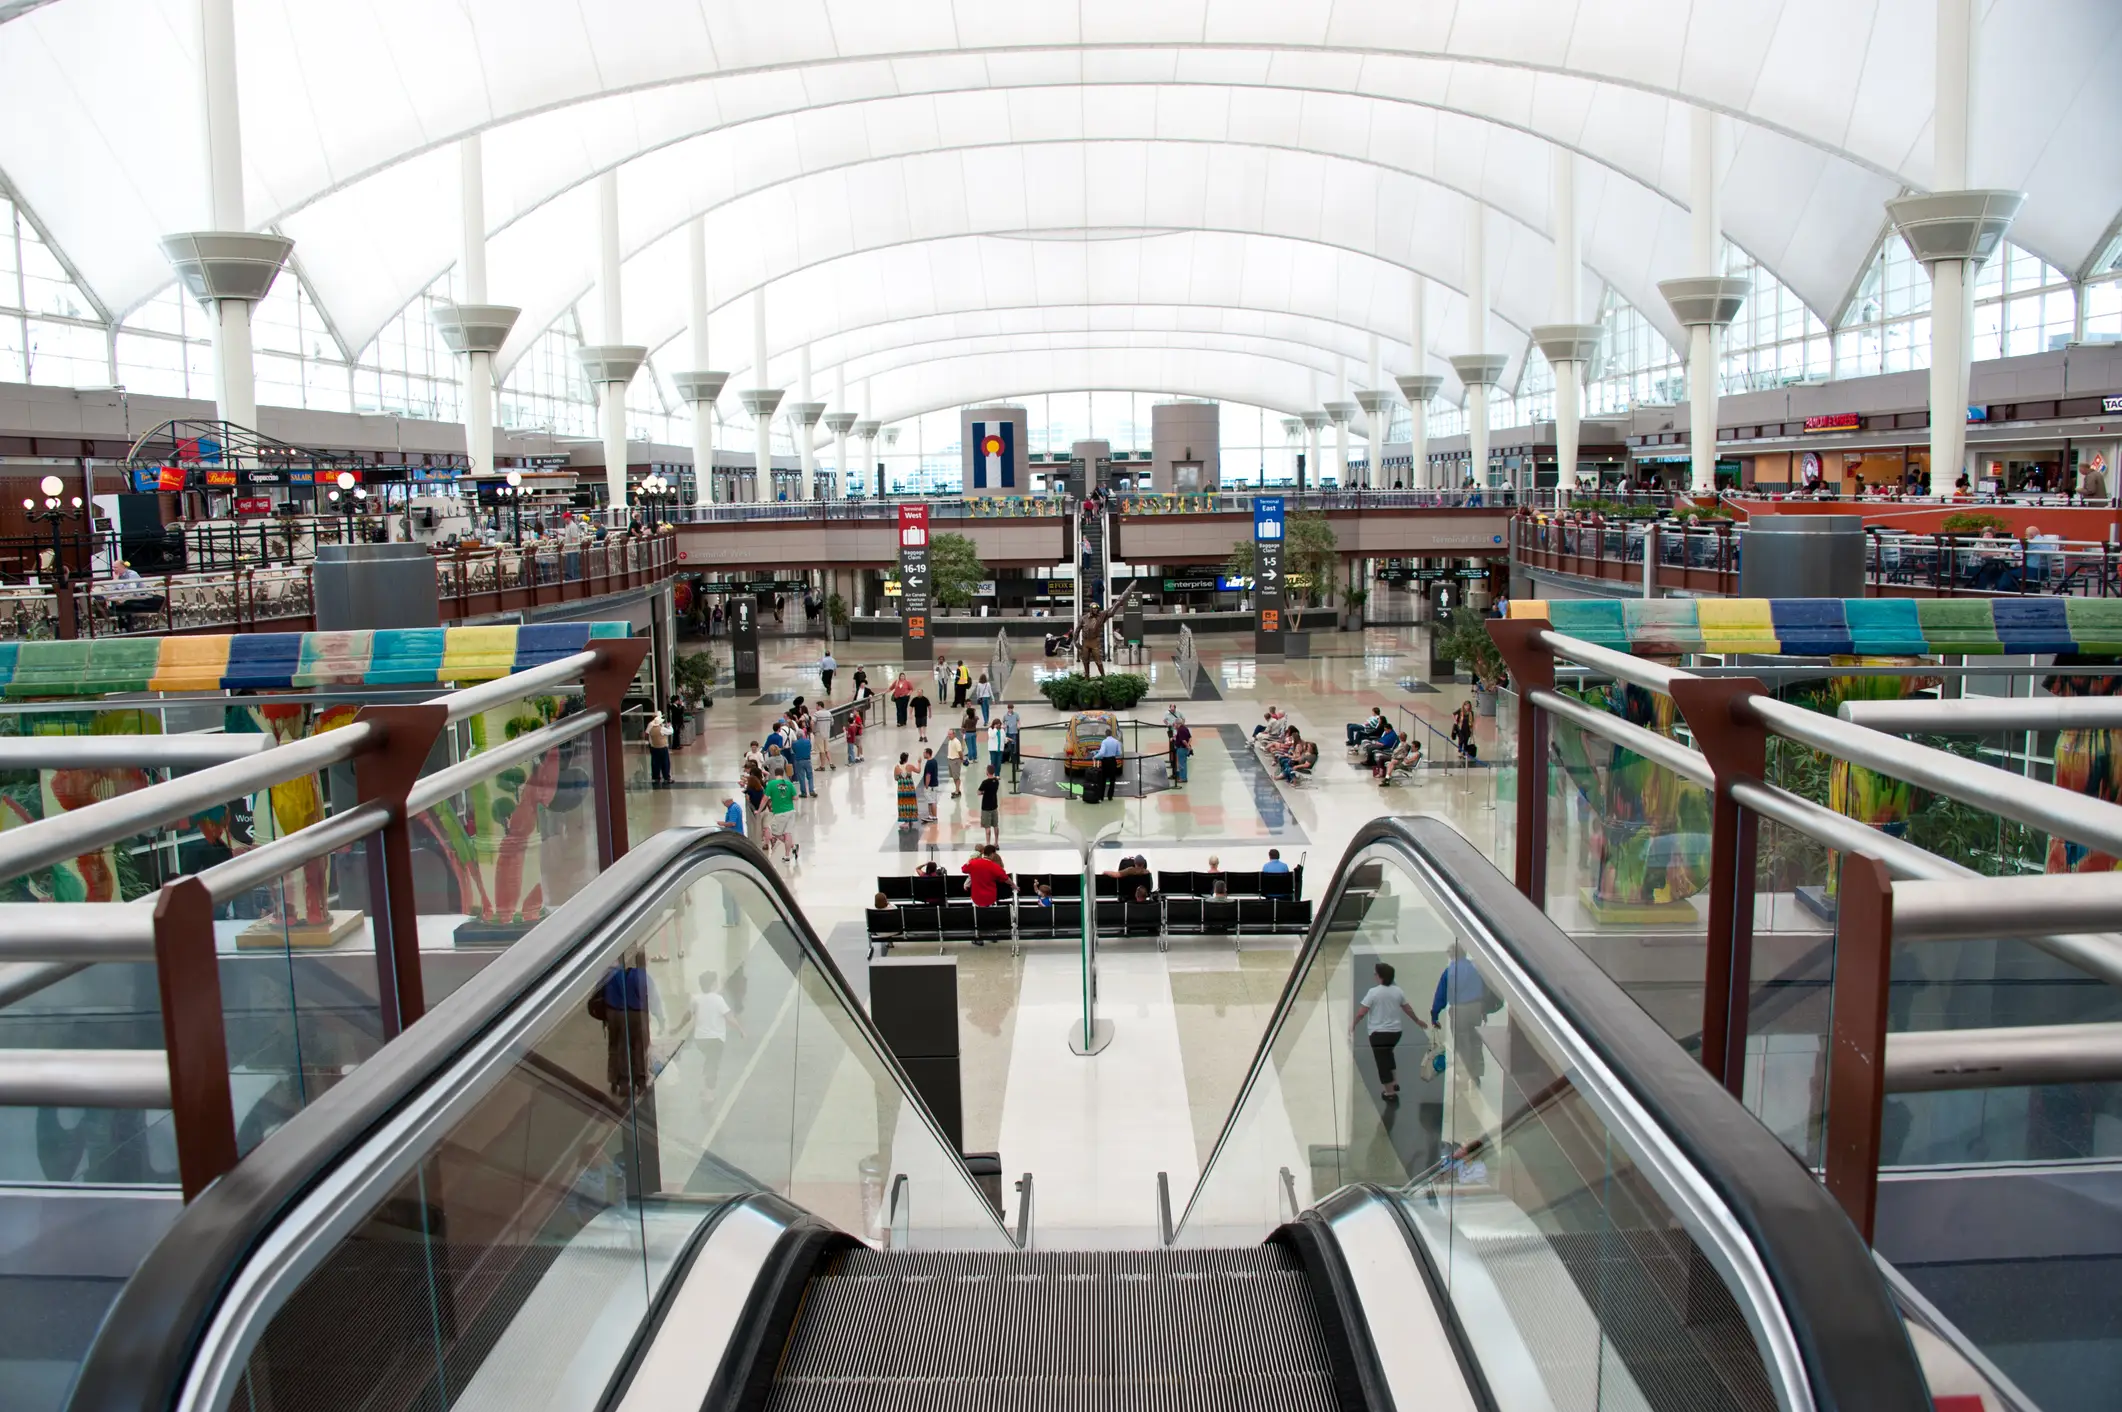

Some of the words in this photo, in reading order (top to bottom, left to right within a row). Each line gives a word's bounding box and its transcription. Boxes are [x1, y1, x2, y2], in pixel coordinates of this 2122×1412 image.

[207, 472, 237, 486] Bakery
[249, 473, 279, 484] Cappuccino
[290, 473, 313, 481] SALADS
[1432, 535, 1468, 543] Terminal
[690, 550, 726, 558] Terminal
[1263, 557, 1277, 566] 1-5
[904, 564, 927, 573] 16-19
[1166, 580, 1213, 589] enterprise
